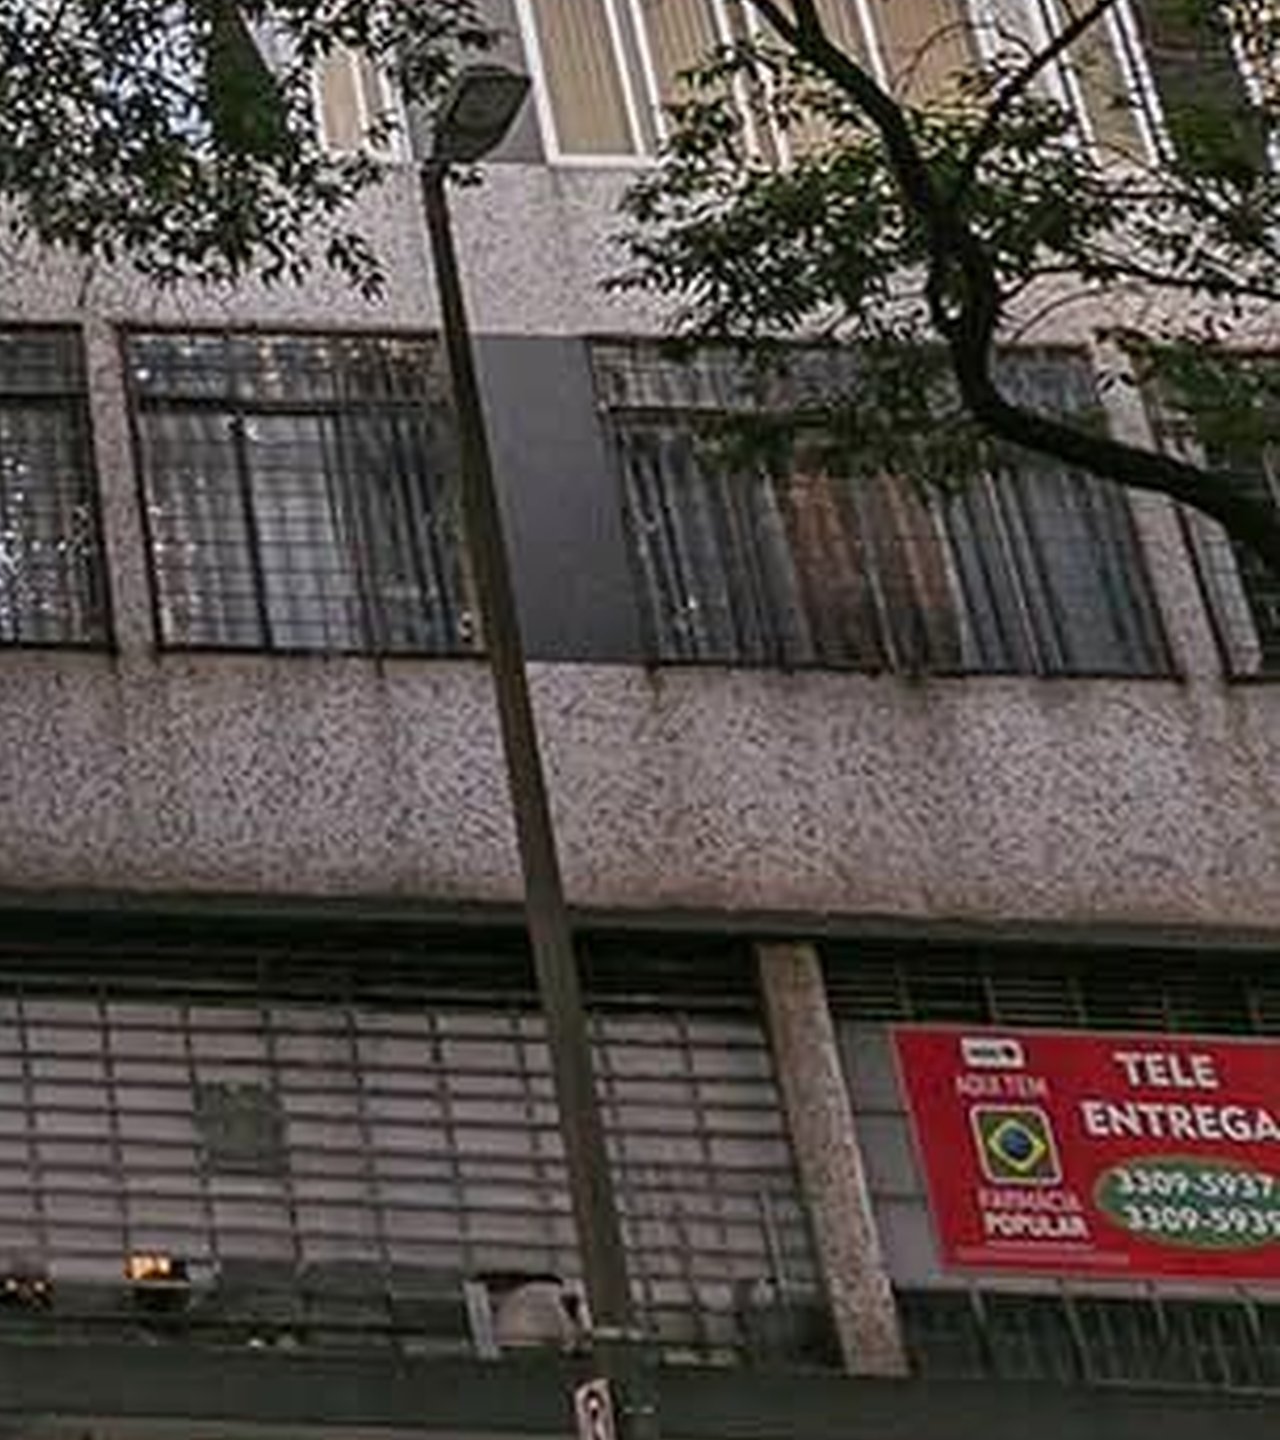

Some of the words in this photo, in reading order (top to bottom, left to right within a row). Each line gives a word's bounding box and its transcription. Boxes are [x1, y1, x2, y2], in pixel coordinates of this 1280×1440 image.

[1113, 1050, 1219, 1089] TELE
[1080, 1100, 1280, 1141] ENTREGA
[985, 1212, 1090, 1239] POPULAR
